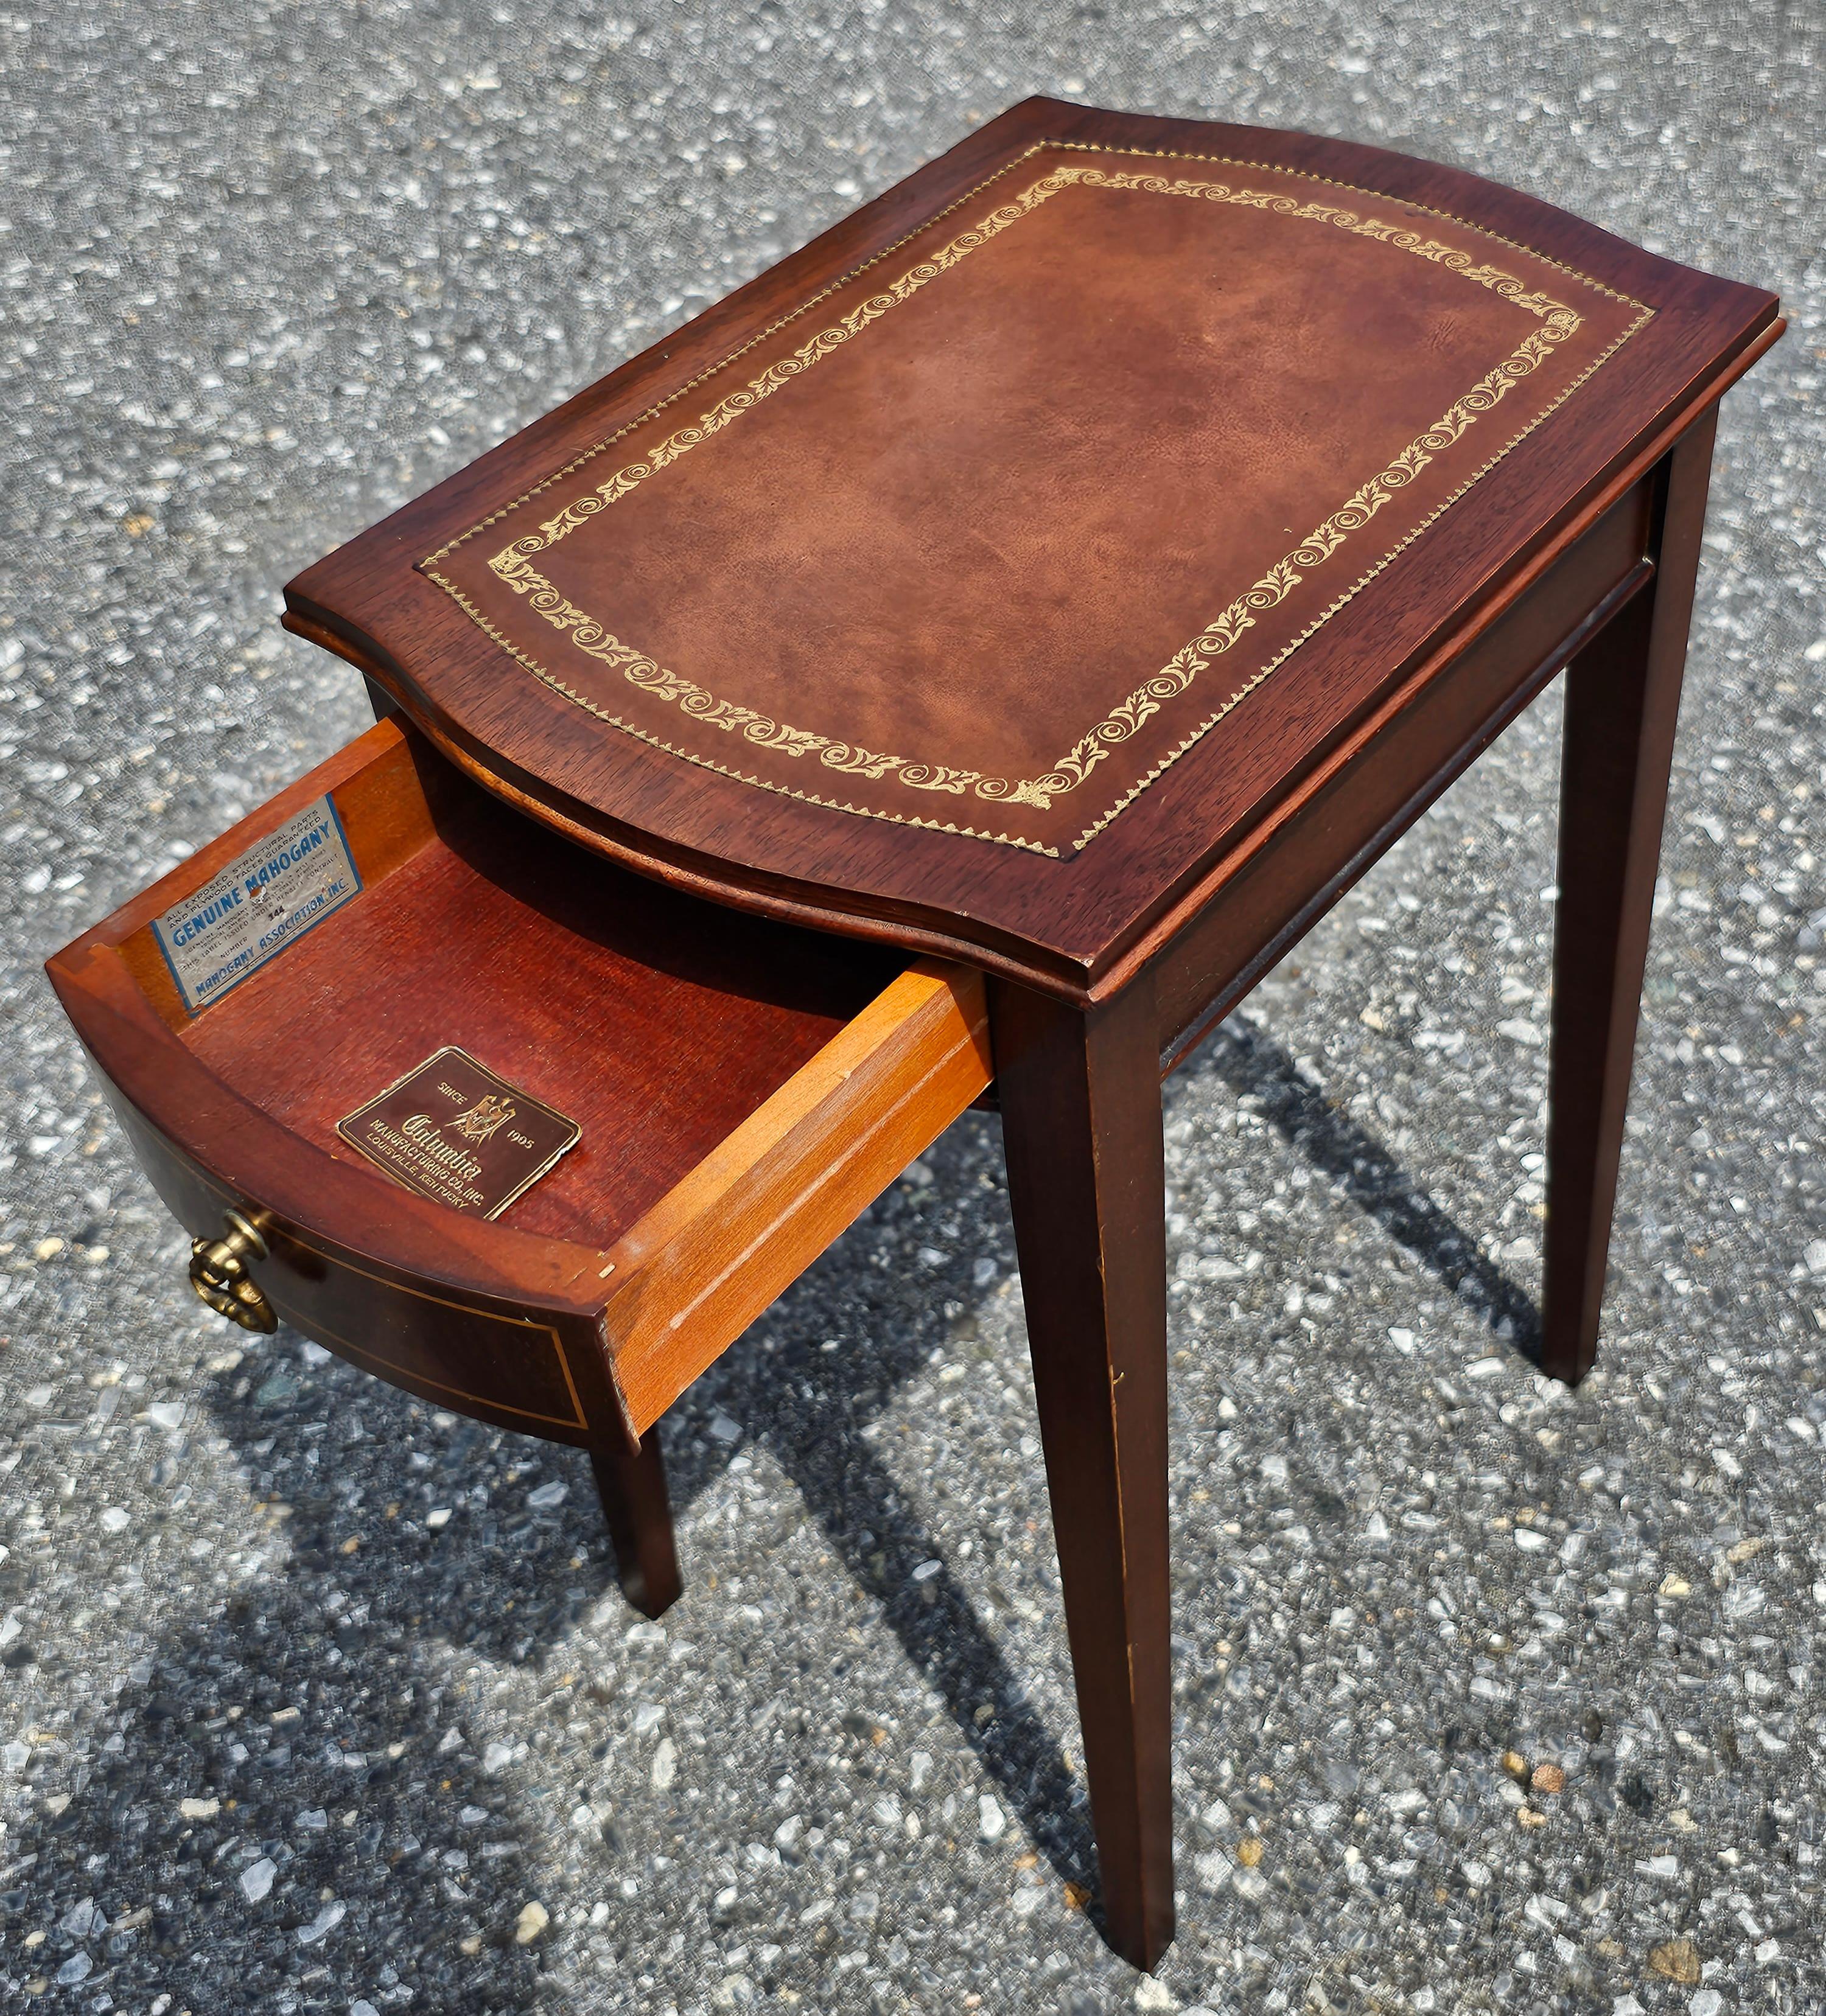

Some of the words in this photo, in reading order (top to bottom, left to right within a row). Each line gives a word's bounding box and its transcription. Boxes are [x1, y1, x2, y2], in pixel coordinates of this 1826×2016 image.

[167, 909, 183, 922] ALL
[185, 874, 229, 909] EXPOSED
[232, 832, 288, 873] STRUCTURAL
[291, 809, 318, 831] PARTS
[169, 913, 189, 929] AND
[191, 879, 234, 914] PLYWOOD
[236, 858, 264, 881] FACES
[266, 815, 321, 859] GUARANTEED
[172, 887, 243, 947] GENUINE
[245, 820, 330, 895] MAHOGANY
[195, 944, 254, 996] MAHOGANY
[327, 877, 349, 897] INC.
[201, 941, 222, 957] LABEL
[224, 920, 248, 940] ISSUED
[251, 901, 273, 921] UNDER
[220, 936, 247, 959] NUMBER
[438, 1082, 468, 1104] SINCE
[366, 1133, 418, 1176] LOUISVILLE,
[419, 1174, 469, 1209] KENTUCKY
[370, 1119, 450, 1180] MANUFACTURING
[465, 1187, 484, 1205] INC.
[402, 1114, 483, 1181] Columbia
[507, 1129, 535, 1149] 1905
